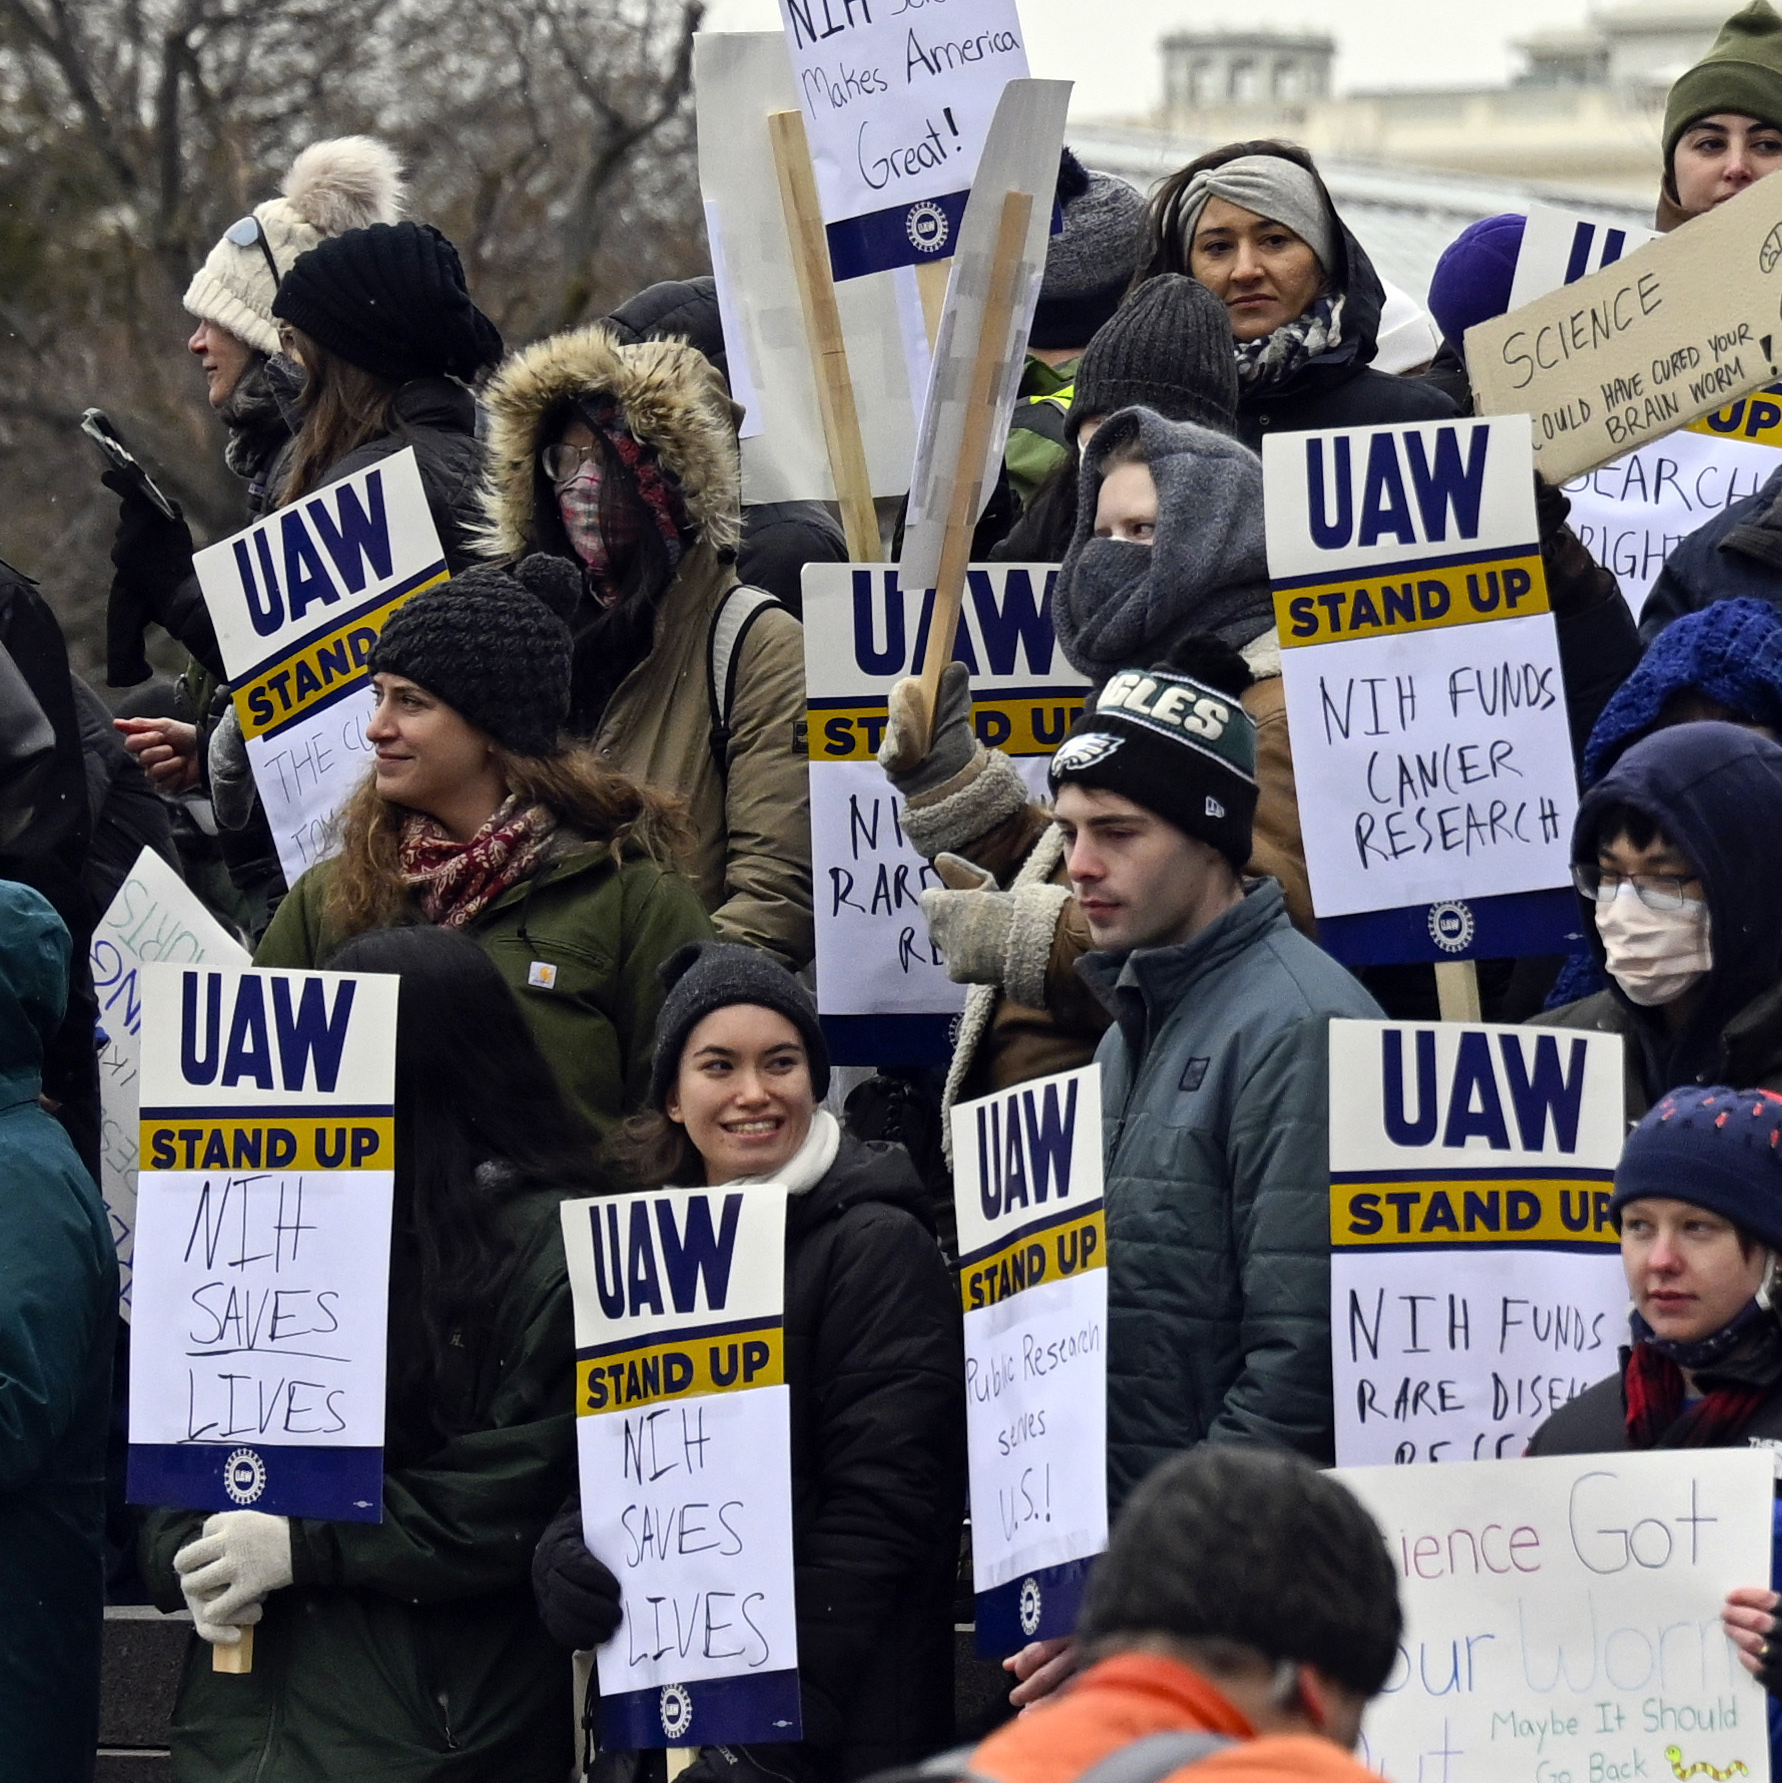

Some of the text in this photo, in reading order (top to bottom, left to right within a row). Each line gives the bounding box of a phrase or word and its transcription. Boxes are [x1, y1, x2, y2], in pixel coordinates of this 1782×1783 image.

[800, 27, 1020, 119] Makes America
[858, 107, 964, 190] Great!
[1502, 272, 1663, 390] SCIENCE
[1600, 372, 1644, 413] HAVE
[1652, 345, 1700, 389] CURED
[1708, 322, 1755, 363] YOUR
[1605, 392, 1679, 444] BRAIN
[1689, 357, 1745, 404] WORM
[1305, 424, 1490, 551] UAW
[232, 468, 394, 638] UAW
[1290, 567, 1531, 638] STAND UP
[1319, 661, 1556, 746] NIH FUNDS
[264, 732, 335, 803] THE
[1366, 739, 1524, 807] CANCER
[1354, 796, 1560, 871] RESEARCH
[180, 971, 357, 1093] UAW
[1381, 1028, 1587, 1154] UAW
[151, 1128, 297, 1169] STAND
[314, 1128, 379, 1167] UP
[976, 1077, 1079, 1222] UAW
[184, 1174, 317, 1273] NIH
[1347, 1189, 1542, 1236] STAND
[588, 1193, 744, 1320] UAW
[969, 1224, 1098, 1310] STAND UP
[189, 1282, 340, 1350] SAVES
[1349, 1287, 1605, 1363] NIH FUNDS
[586, 1339, 771, 1409] STAND UP
[966, 1319, 1101, 1408] Public Research
[1357, 1376, 1466, 1424] RARE
[189, 1368, 347, 1441] LIVES
[622, 1406, 711, 1482] NIH
[621, 1500, 744, 1568] SAVES
[1569, 1470, 1718, 1575] Got
[626, 1590, 770, 1668] LIVES
[1490, 1695, 1739, 1751] Maybe It Should
[1589, 1754, 1648, 1782] Back
